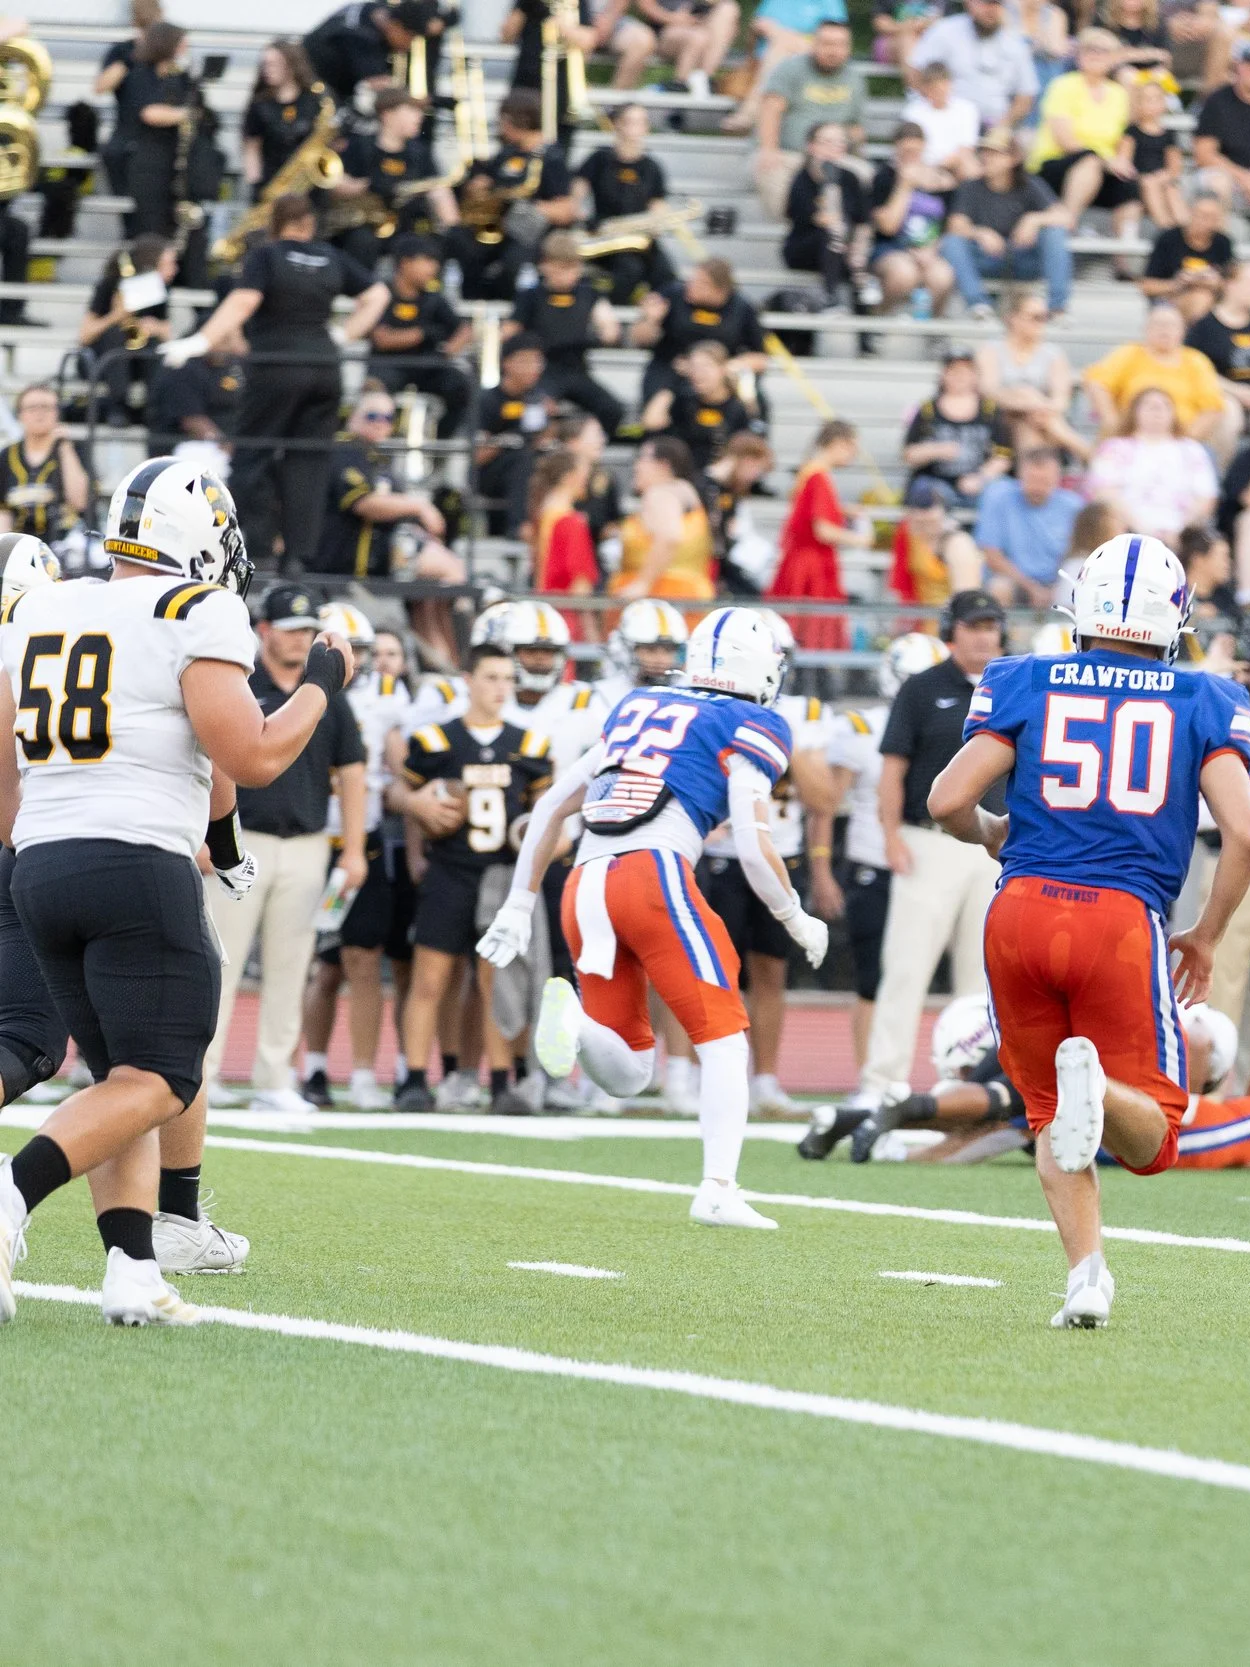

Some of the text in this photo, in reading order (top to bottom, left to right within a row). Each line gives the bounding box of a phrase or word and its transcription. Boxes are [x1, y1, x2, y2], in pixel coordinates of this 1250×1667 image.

[13, 631, 114, 764] 58
[692, 674, 736, 691] Riddell
[1050, 663, 1175, 692] CRAWFORD
[599, 698, 699, 777] 22
[1041, 691, 1176, 816] 50
[468, 787, 506, 853] 9
[1041, 883, 1100, 904] NORTHWEST
